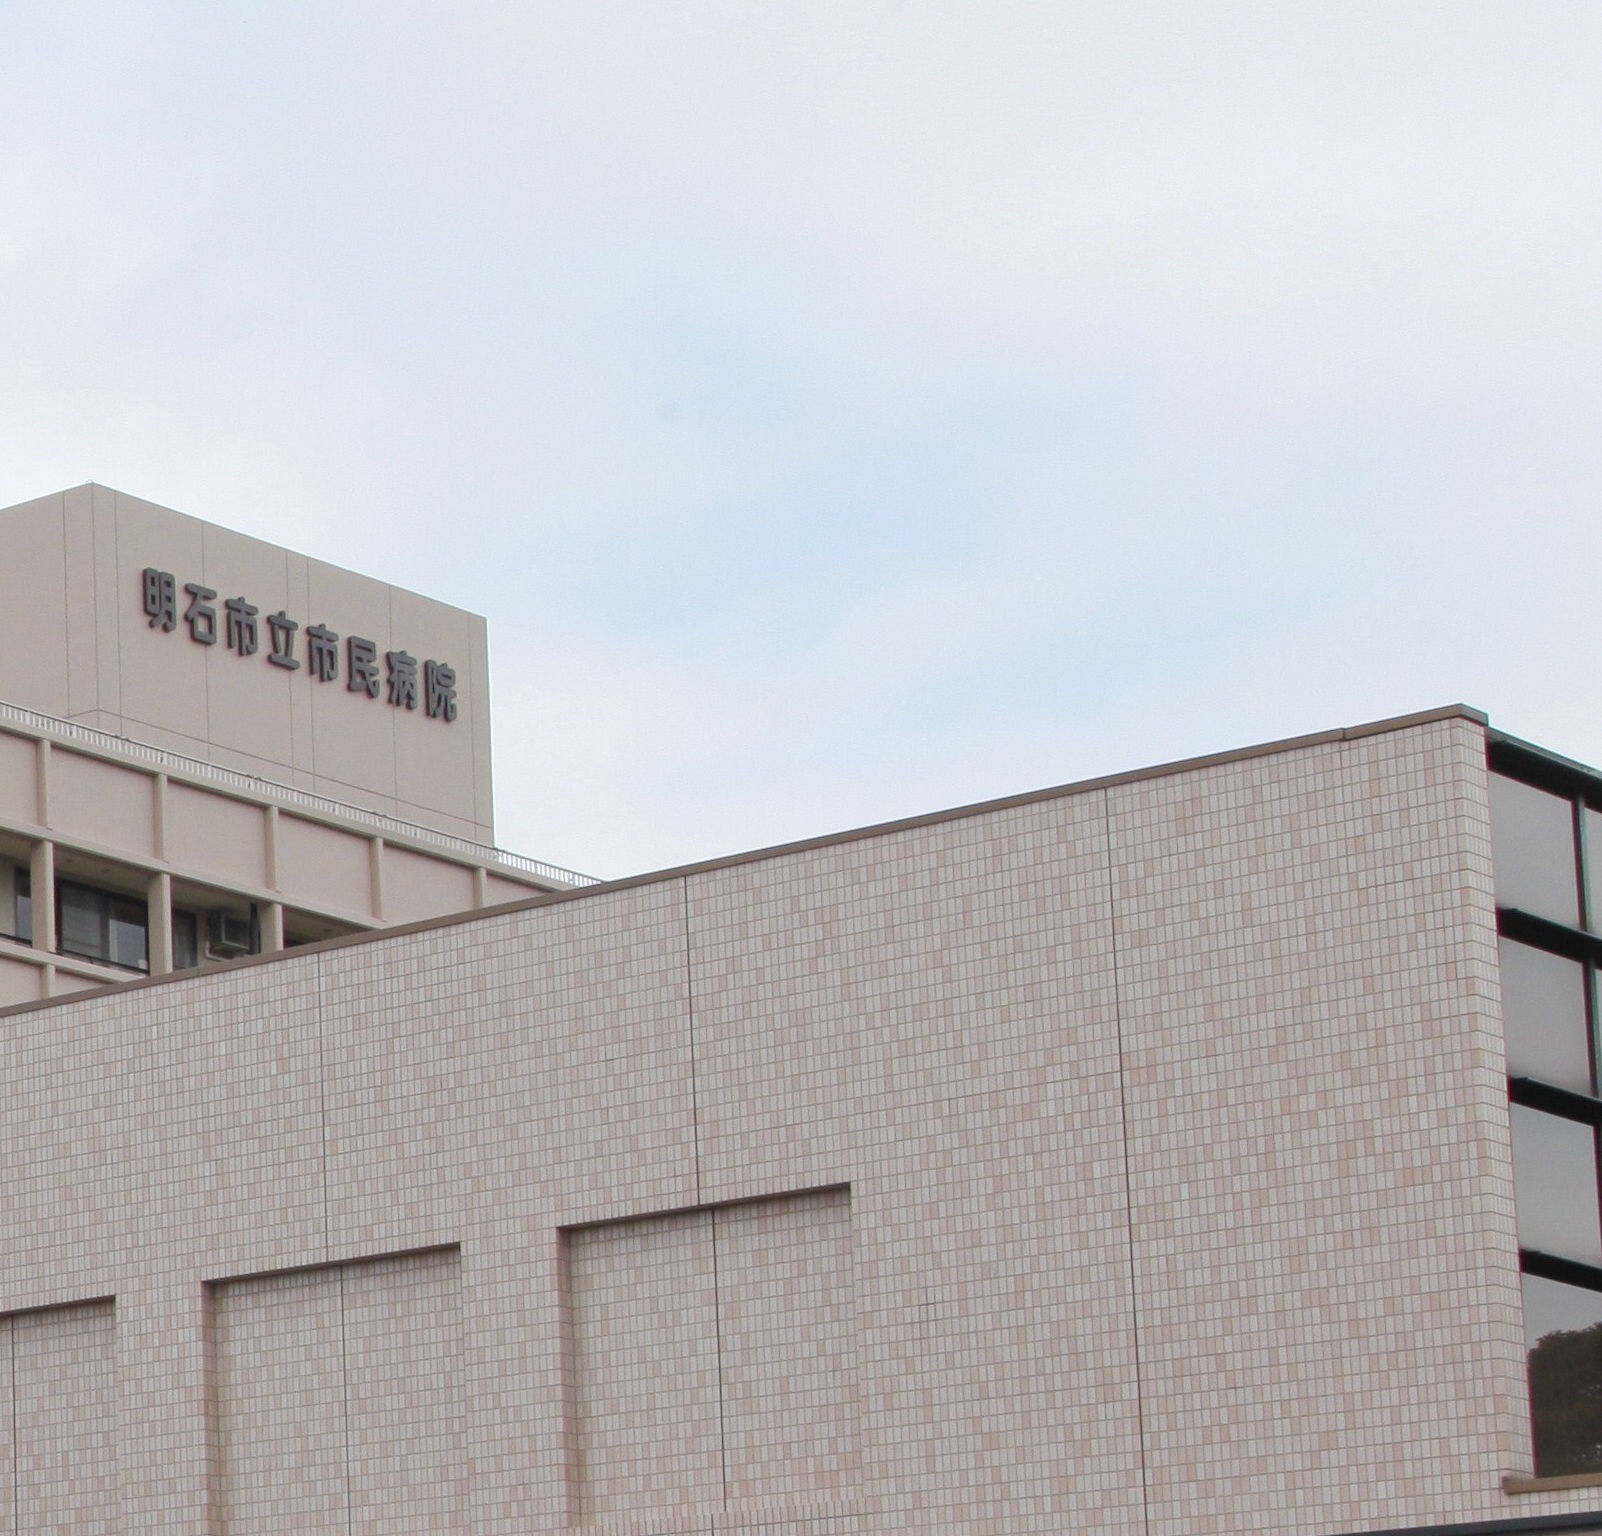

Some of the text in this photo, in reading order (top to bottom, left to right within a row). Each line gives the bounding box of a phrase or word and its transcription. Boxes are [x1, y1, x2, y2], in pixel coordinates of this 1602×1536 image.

[142, 566, 459, 723] 明石市立市民病院
